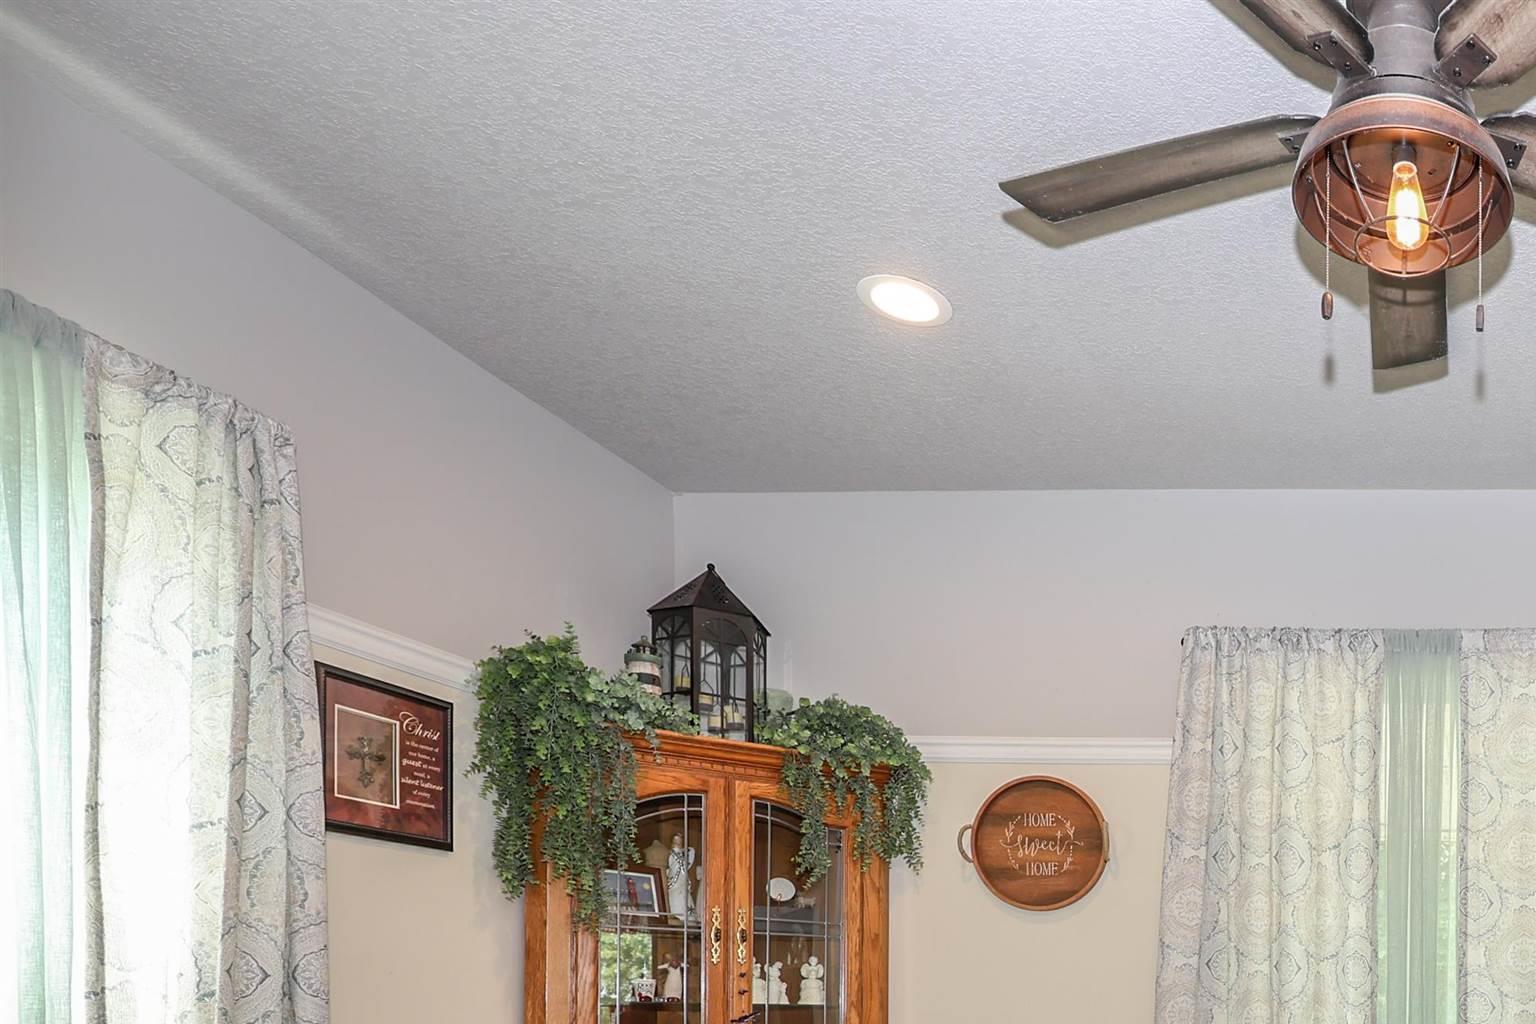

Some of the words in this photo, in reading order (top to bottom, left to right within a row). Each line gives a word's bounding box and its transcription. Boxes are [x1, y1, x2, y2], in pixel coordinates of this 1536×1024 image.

[399, 711, 440, 740] Christ
[1023, 812, 1057, 827] HOME
[1025, 861, 1059, 876] HOME
